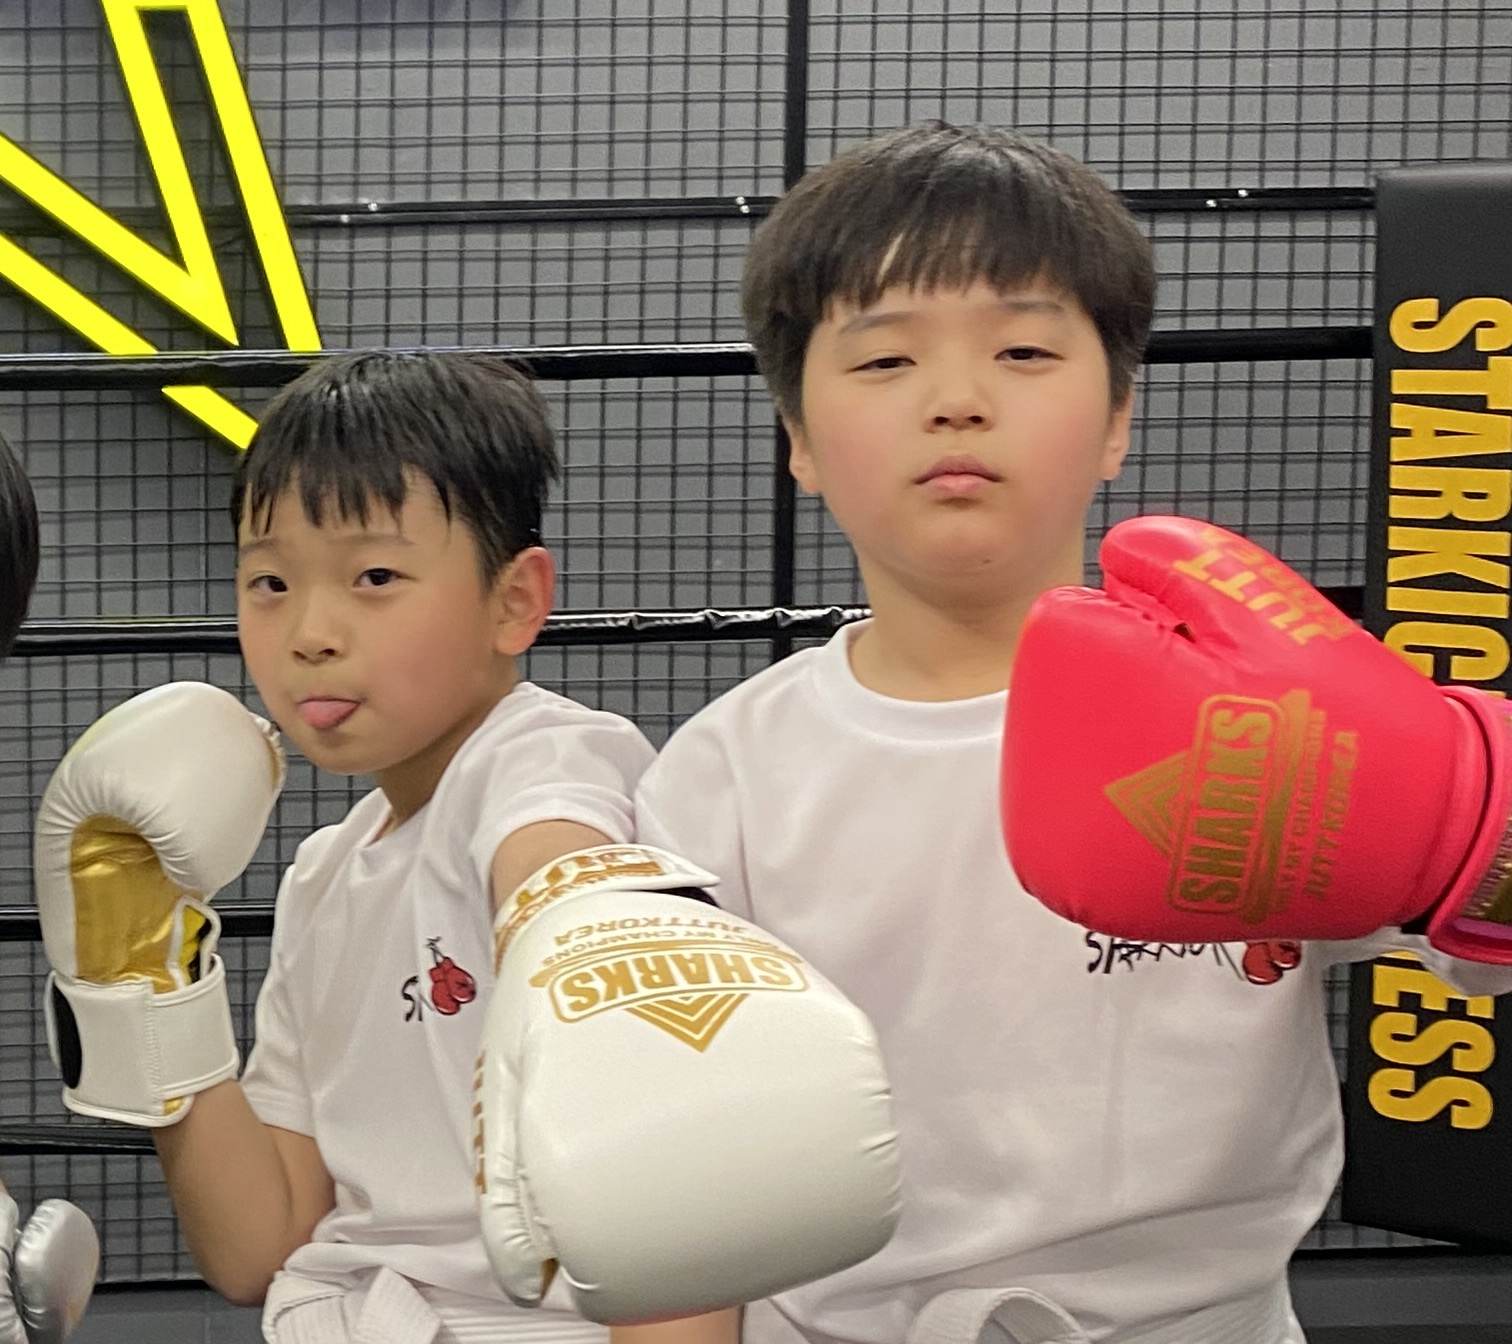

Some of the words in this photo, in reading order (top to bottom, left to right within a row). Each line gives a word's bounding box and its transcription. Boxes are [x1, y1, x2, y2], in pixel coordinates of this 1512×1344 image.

[1384, 297, 1512, 700] STARKIC
[1173, 549, 1330, 646] JUTT
[1180, 709, 1272, 904] SHARKS
[561, 953, 793, 1012] SHARKS
[1368, 950, 1496, 1130] ESS
